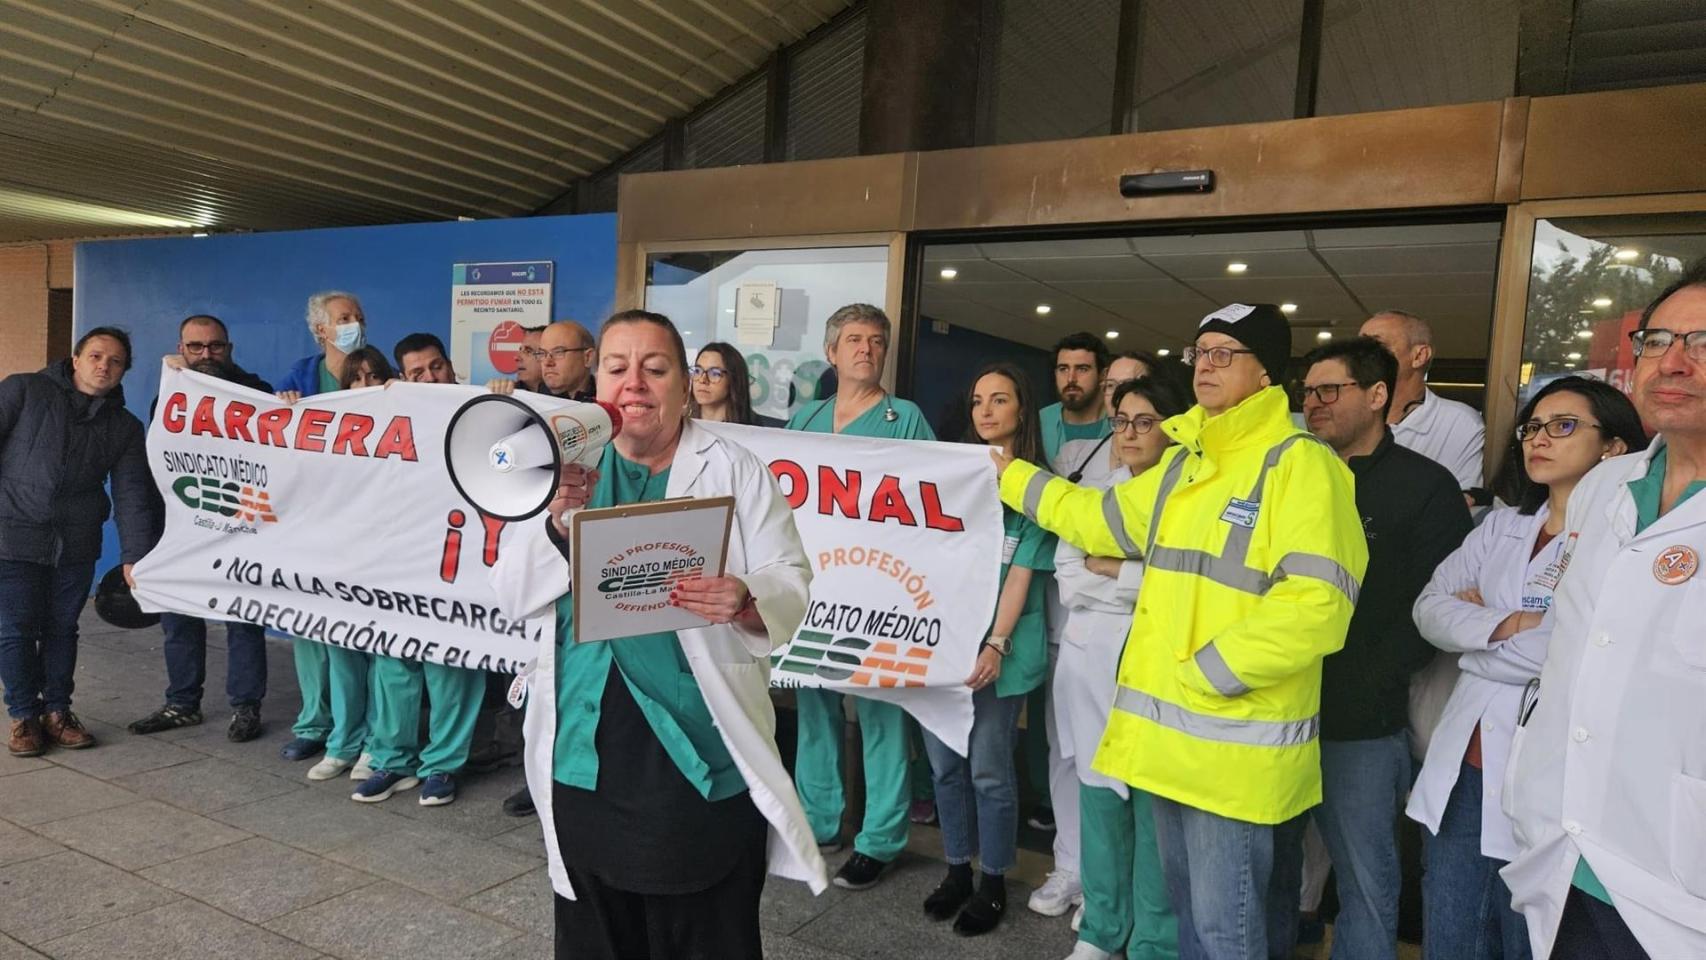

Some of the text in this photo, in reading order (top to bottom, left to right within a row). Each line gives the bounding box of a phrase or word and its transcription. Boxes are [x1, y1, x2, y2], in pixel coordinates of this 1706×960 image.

[490, 298, 512, 306] FUMAR
[517, 288, 527, 296] NO
[163, 392, 418, 462] CARRERA
[163, 450, 268, 488] SINDICATO MÉDICO
[172, 476, 278, 523] CESM
[601, 556, 705, 579] SINDICATO MÉDICO
[607, 542, 697, 566] TU PROFESIÓN
[226, 557, 263, 586] NO
[271, 568, 292, 590] A
[294, 572, 334, 598] LA
[334, 581, 526, 640] SOBRECARGA
[604, 588, 657, 600] Castilla-La
[818, 546, 936, 611] PROFESIÓN
[226, 596, 398, 657] ADECUACIÓN
[400, 637, 440, 662] DE
[862, 605, 942, 647] MÉDICO
